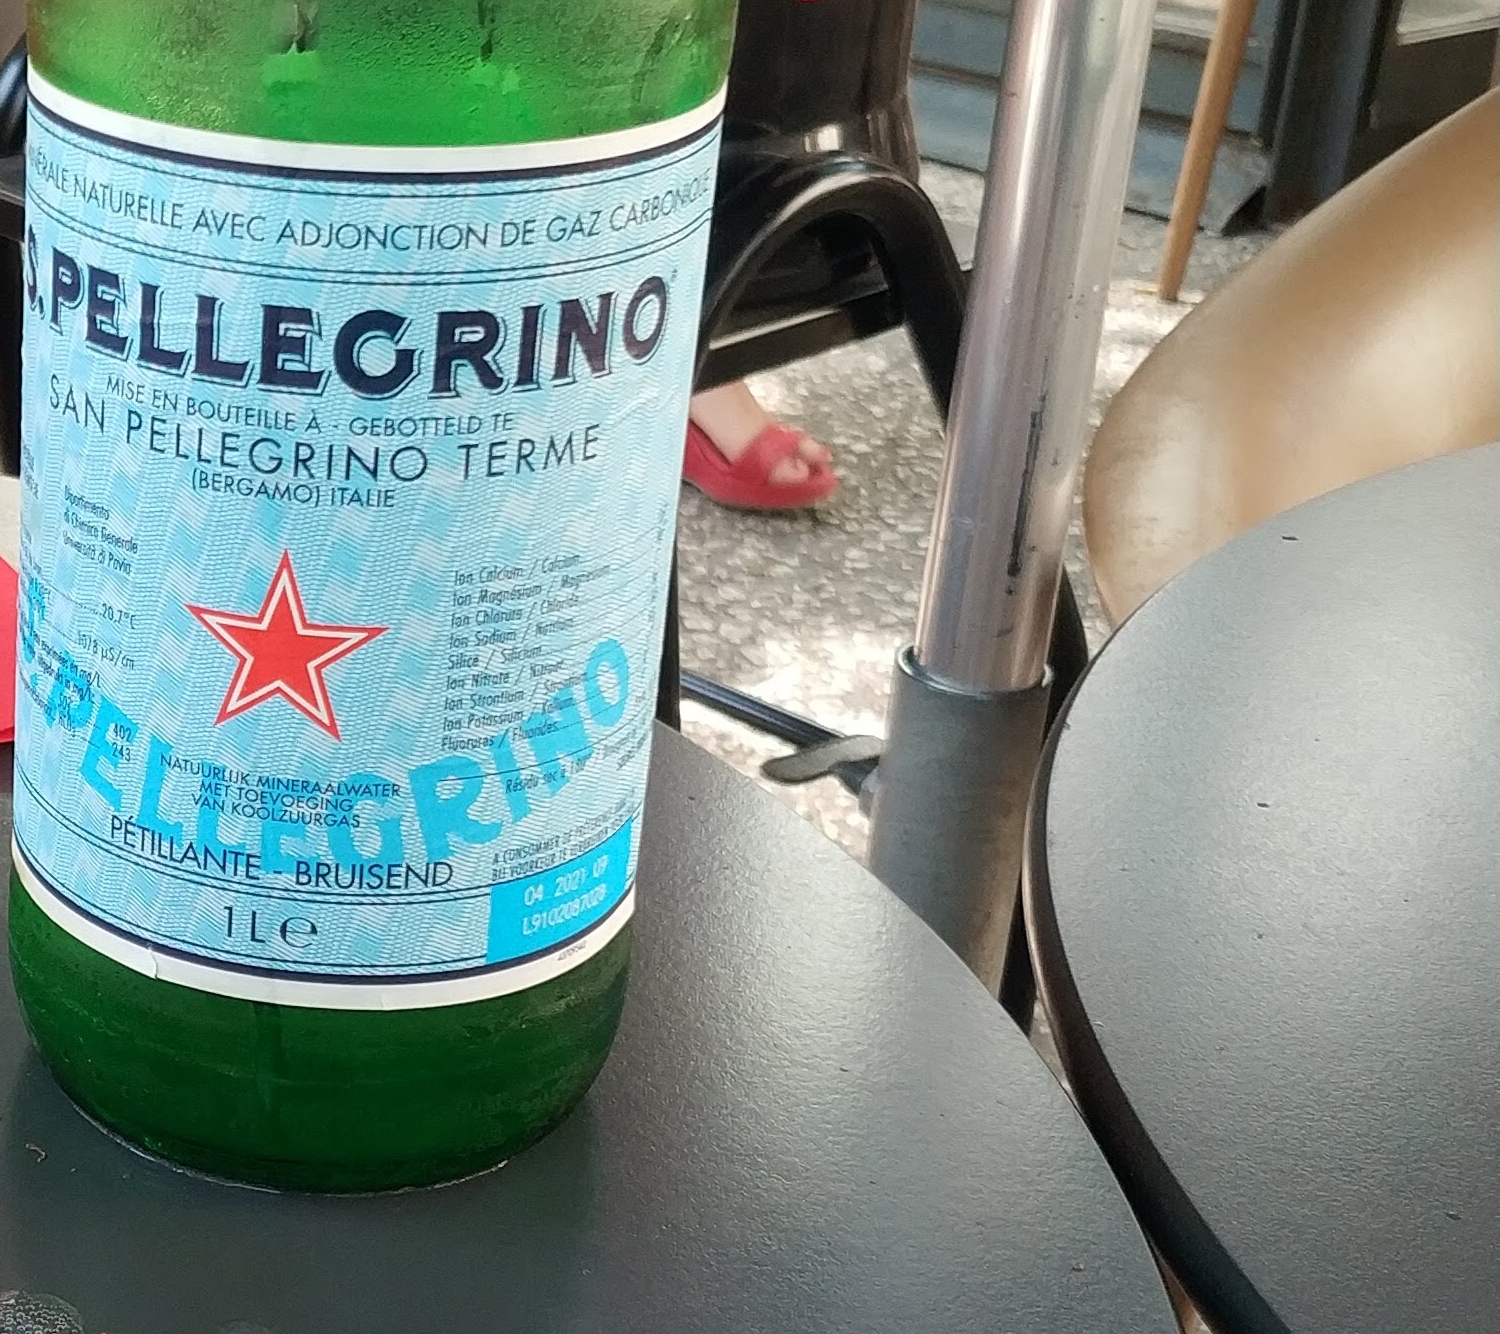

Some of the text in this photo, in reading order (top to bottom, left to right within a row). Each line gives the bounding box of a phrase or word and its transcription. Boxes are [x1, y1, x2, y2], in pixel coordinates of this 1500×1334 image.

[73, 173, 184, 230] NATURELLE
[192, 209, 267, 243] AVEC
[277, 219, 489, 252] ADJONCTION
[501, 219, 536, 247] DE
[546, 210, 602, 243] GAZ
[26, 223, 672, 400] S.PELLEGRINO
[48, 374, 601, 482] SAN PELLEGRINO TERME
[106, 376, 148, 405] MISE
[152, 388, 180, 411] EN
[186, 396, 298, 434] BOUTEILLE
[304, 404, 323, 434] À
[348, 412, 486, 438] GEBOTTELD
[490, 410, 516, 434] TE
[191, 468, 396, 509] (BERGAMO) ITALIE
[111, 741, 132, 763] 243
[112, 722, 132, 743] 402
[160, 753, 401, 798] NATUURLIJK MINERAALWATER
[200, 780, 354, 813] MET TOEVOEGING
[191, 793, 361, 829] VAN KOOLZUURGAS
[109, 814, 262, 882] PÉTILLANTE
[294, 861, 454, 891] BRUISEND
[524, 884, 545, 906] 04
